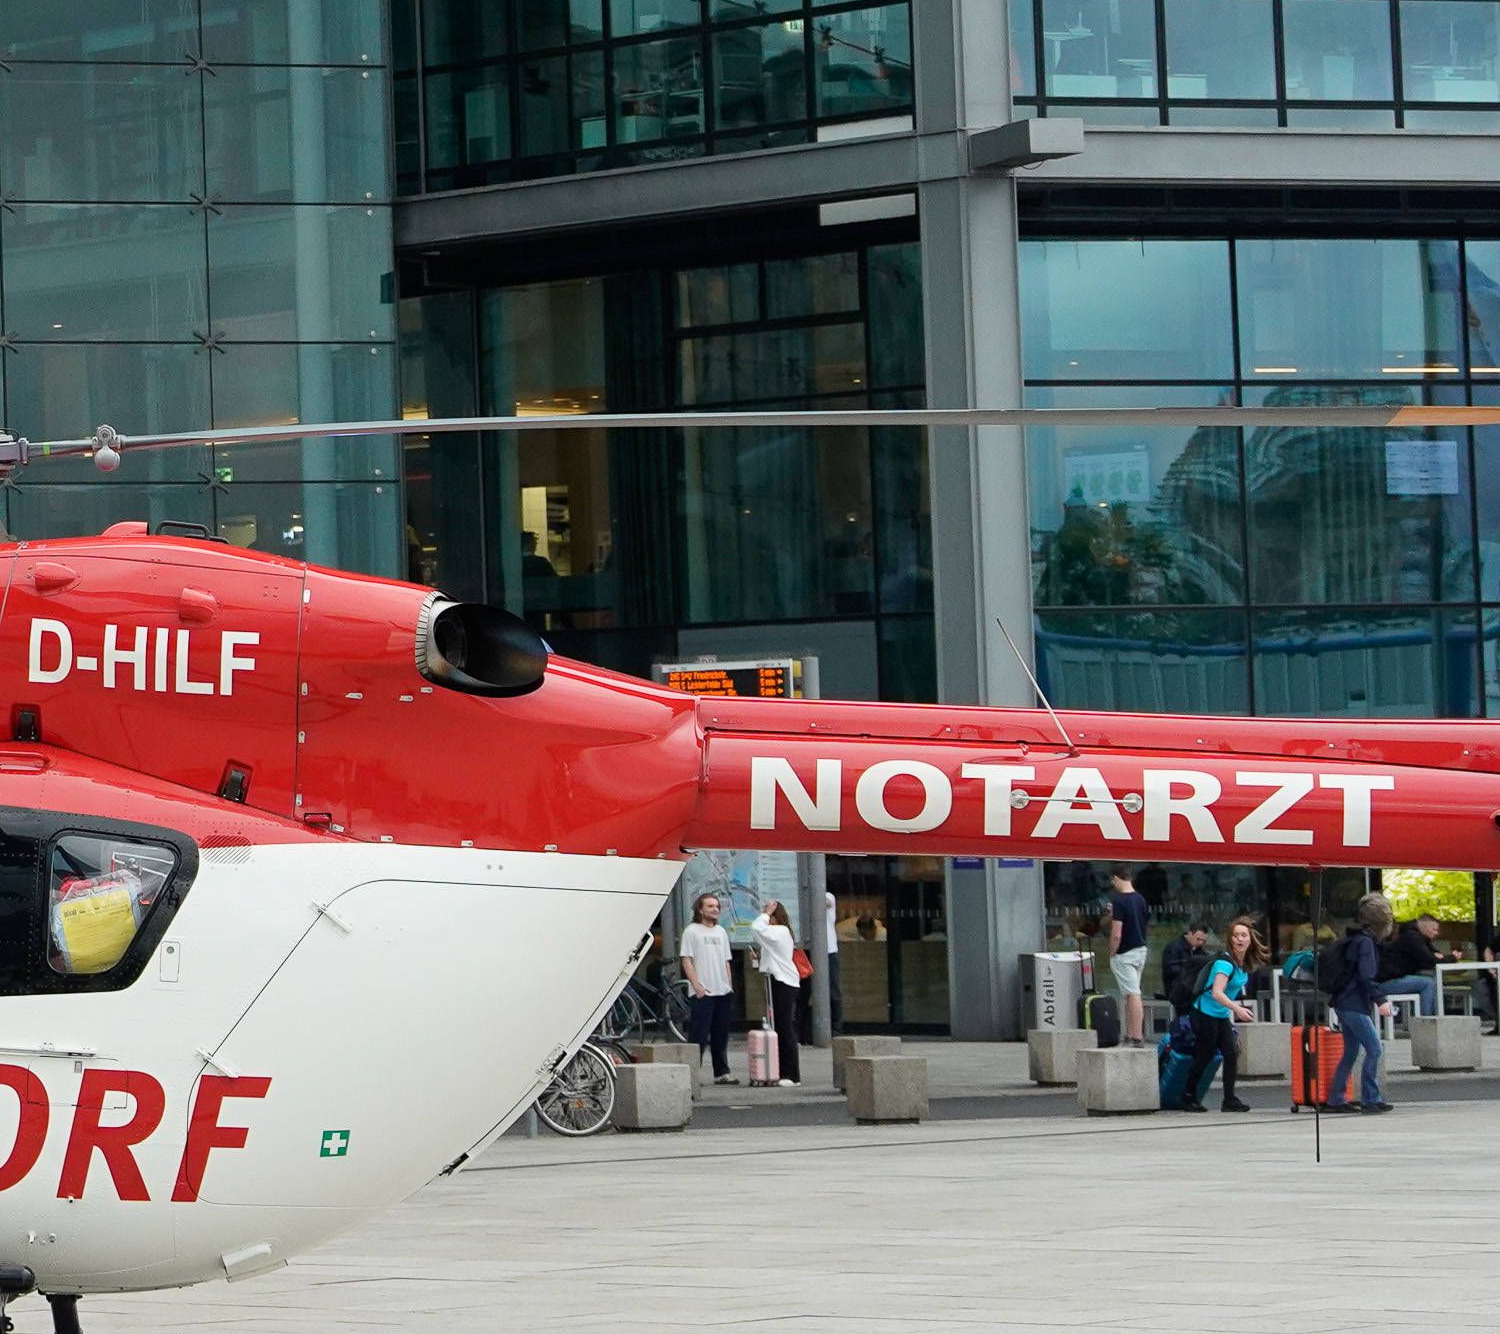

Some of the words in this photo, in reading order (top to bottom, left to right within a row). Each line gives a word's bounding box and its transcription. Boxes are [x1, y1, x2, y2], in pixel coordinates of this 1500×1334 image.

[28, 617, 261, 697] D-HILF
[750, 756, 1395, 847] NOTARZT
[1043, 979, 1055, 1026] Abfall
